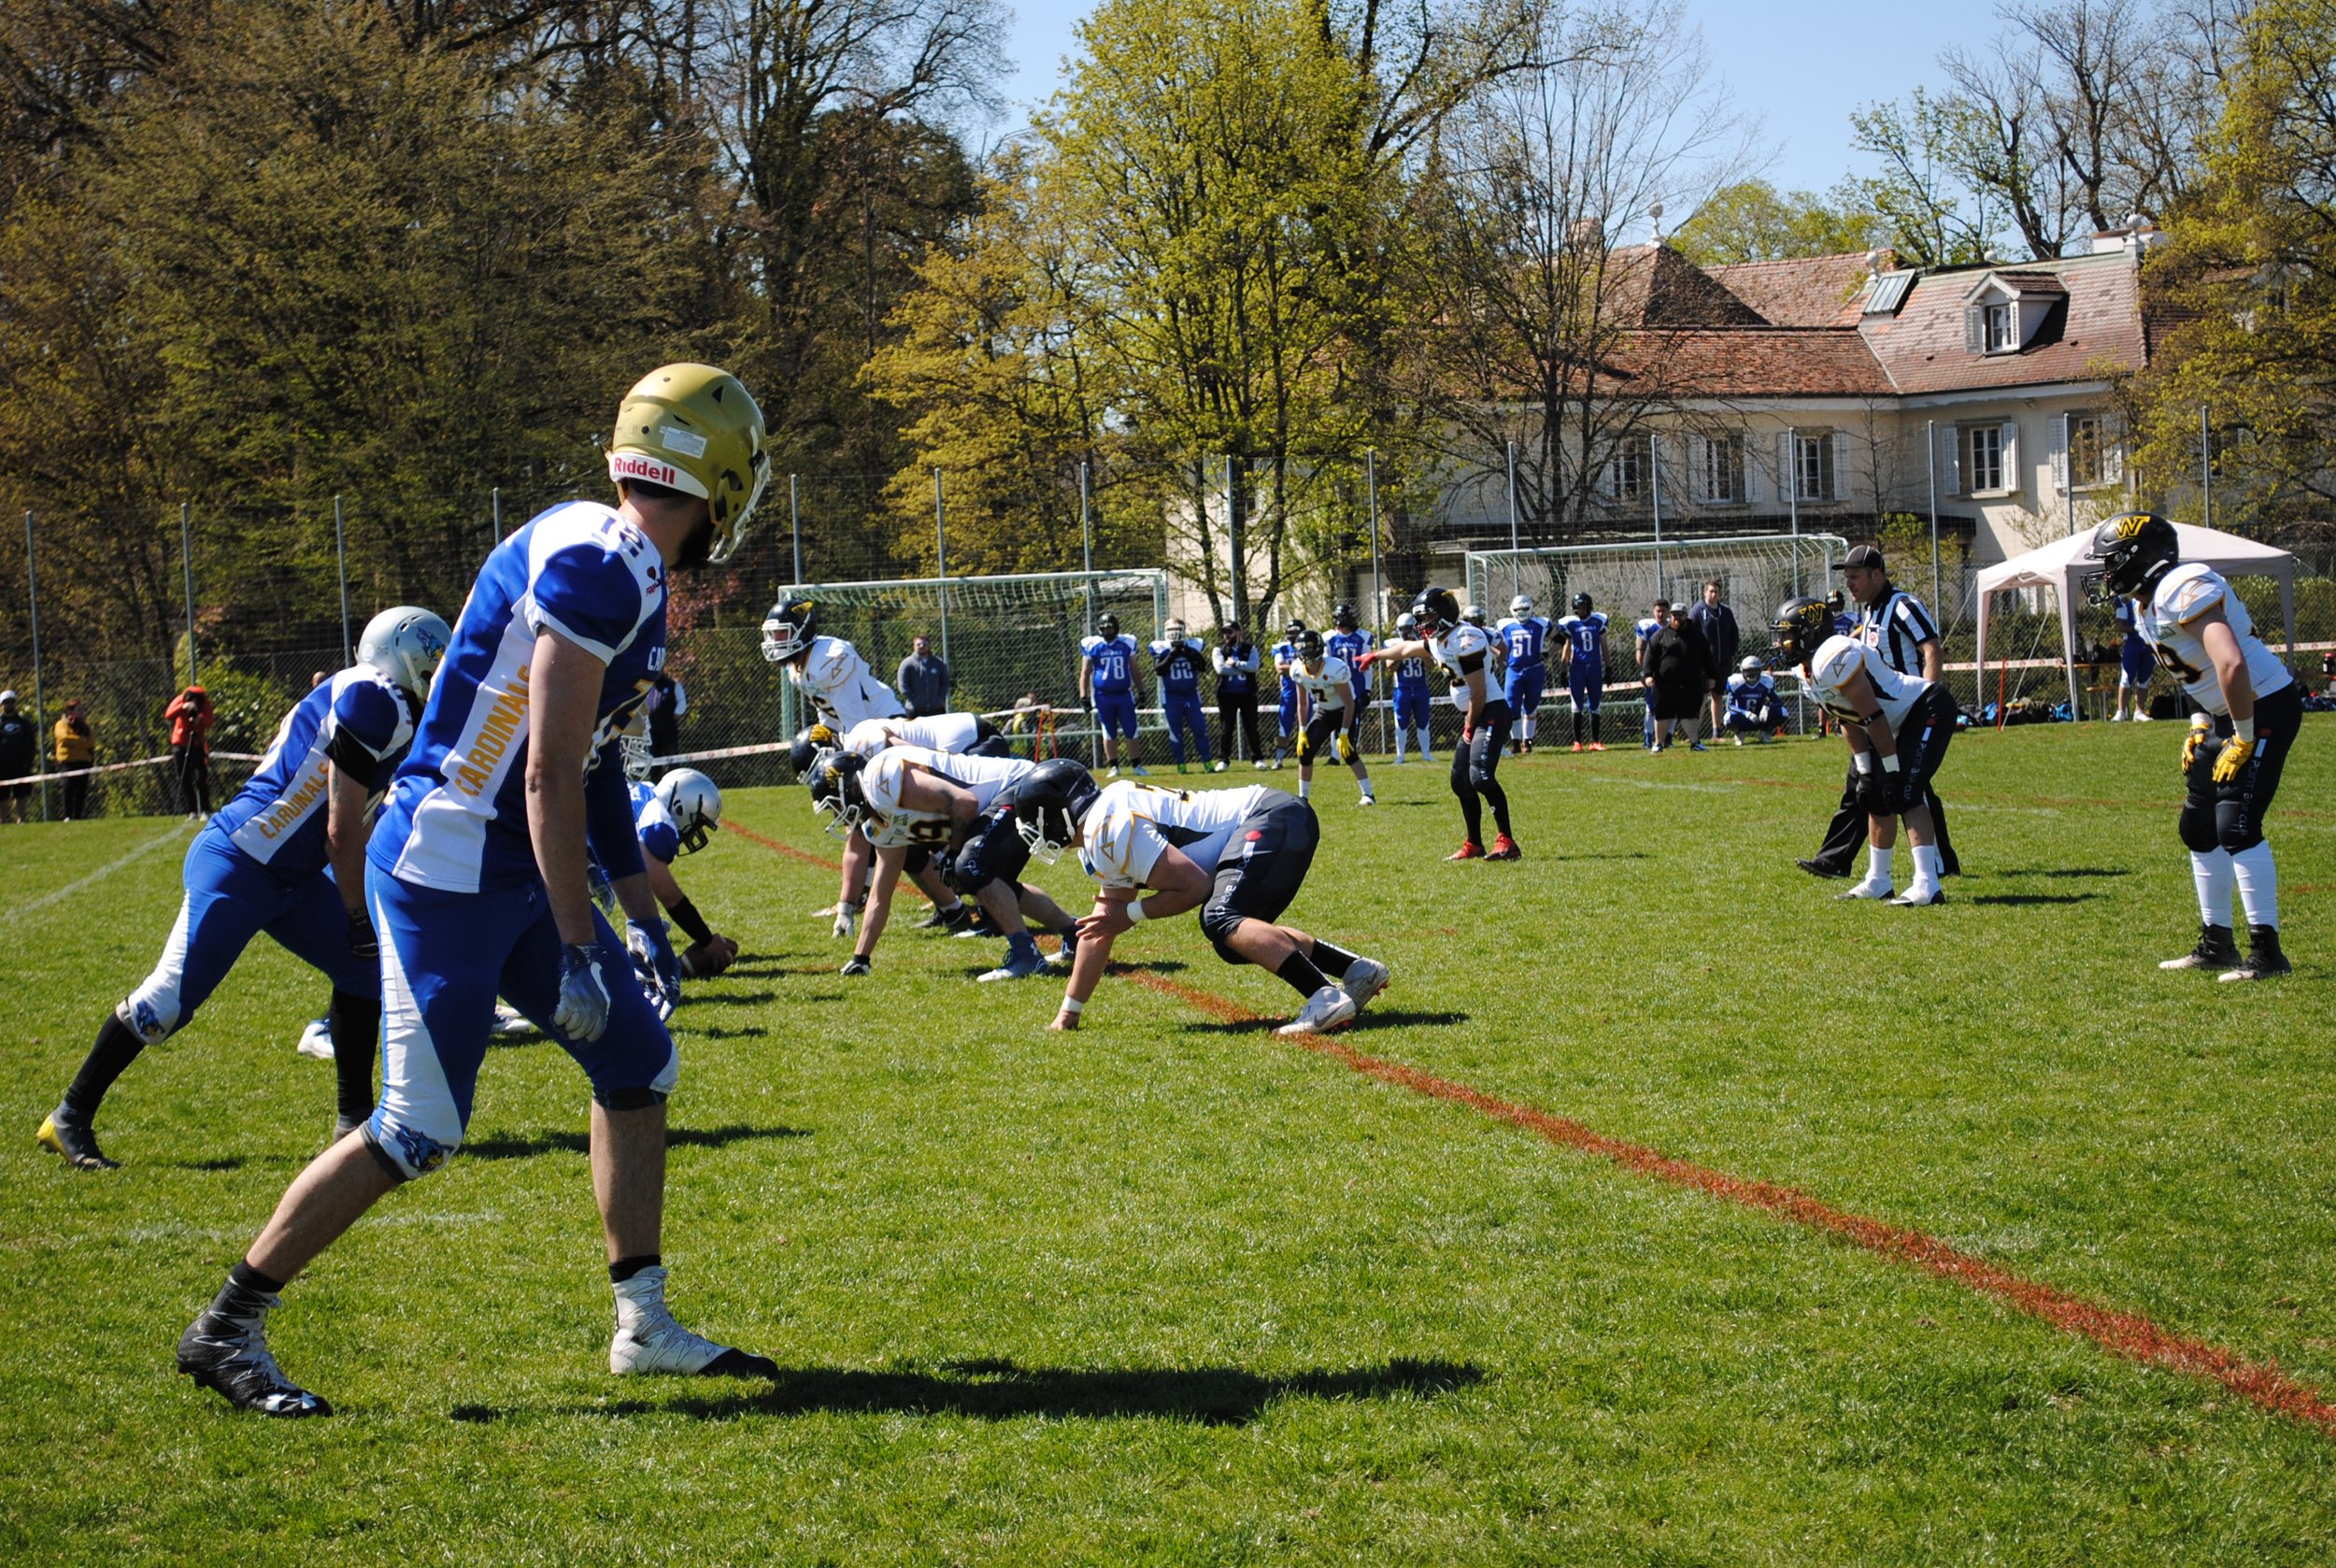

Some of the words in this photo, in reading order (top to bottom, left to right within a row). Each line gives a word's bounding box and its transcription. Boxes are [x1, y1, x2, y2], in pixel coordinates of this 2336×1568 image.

[614, 457, 676, 484] Riddell
[2114, 516, 2150, 539] W
[1511, 634, 1532, 658] 57
[1100, 655, 1124, 680] 78
[1403, 657, 1422, 677] 33
